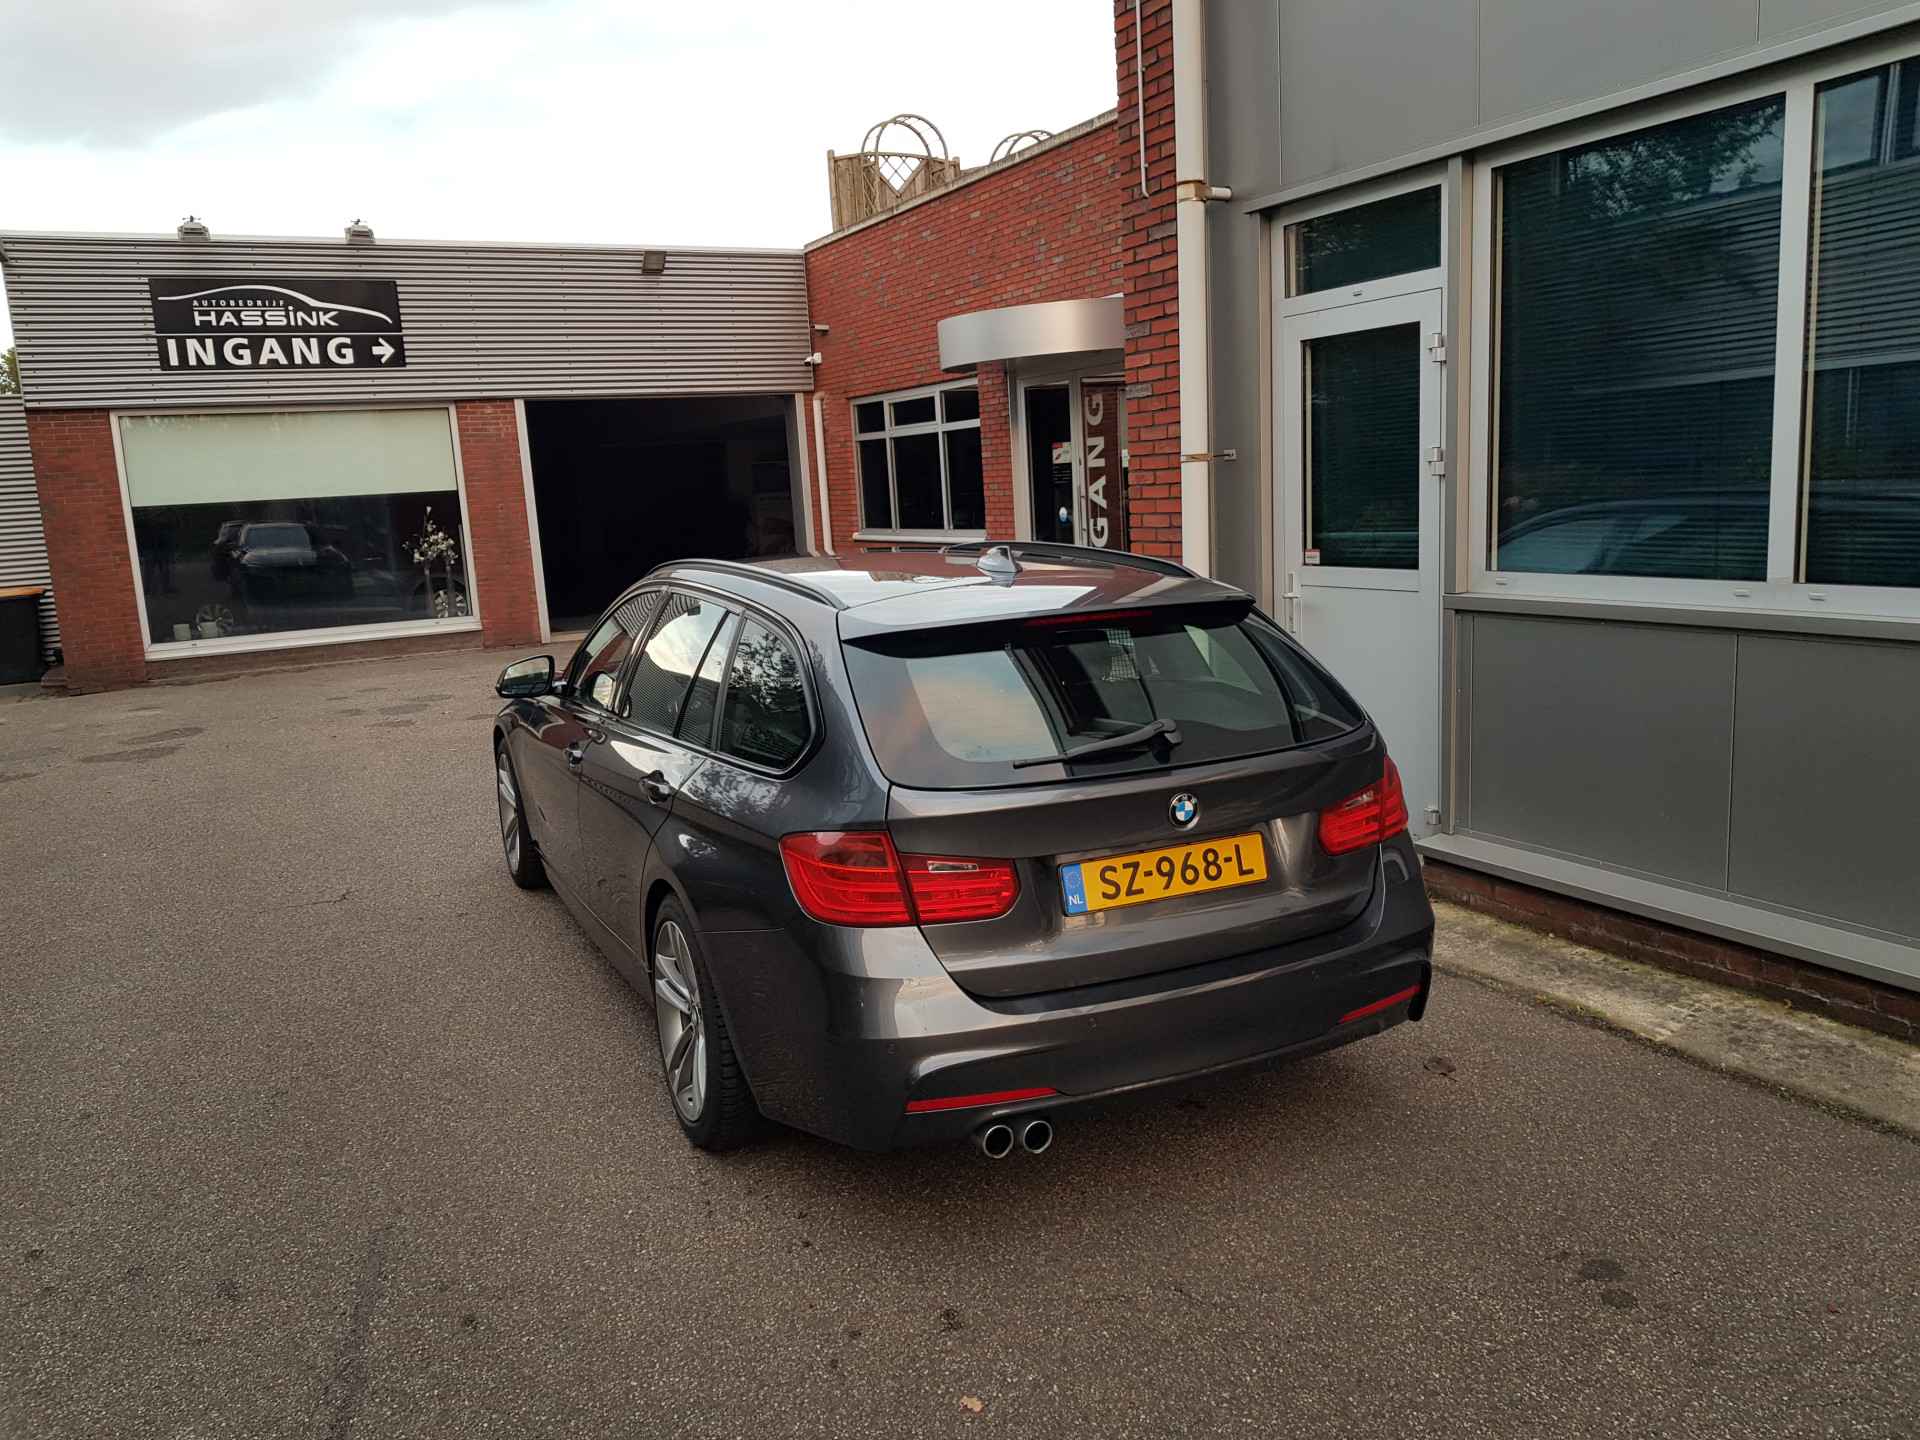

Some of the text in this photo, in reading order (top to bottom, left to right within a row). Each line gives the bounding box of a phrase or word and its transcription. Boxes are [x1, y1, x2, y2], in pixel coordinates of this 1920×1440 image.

[192, 299, 285, 307] AUTOBEDRIJF
[166, 337, 355, 367] INGANG
[1099, 843, 1255, 900] SZ-968-L
[1068, 895, 1084, 905] NL
